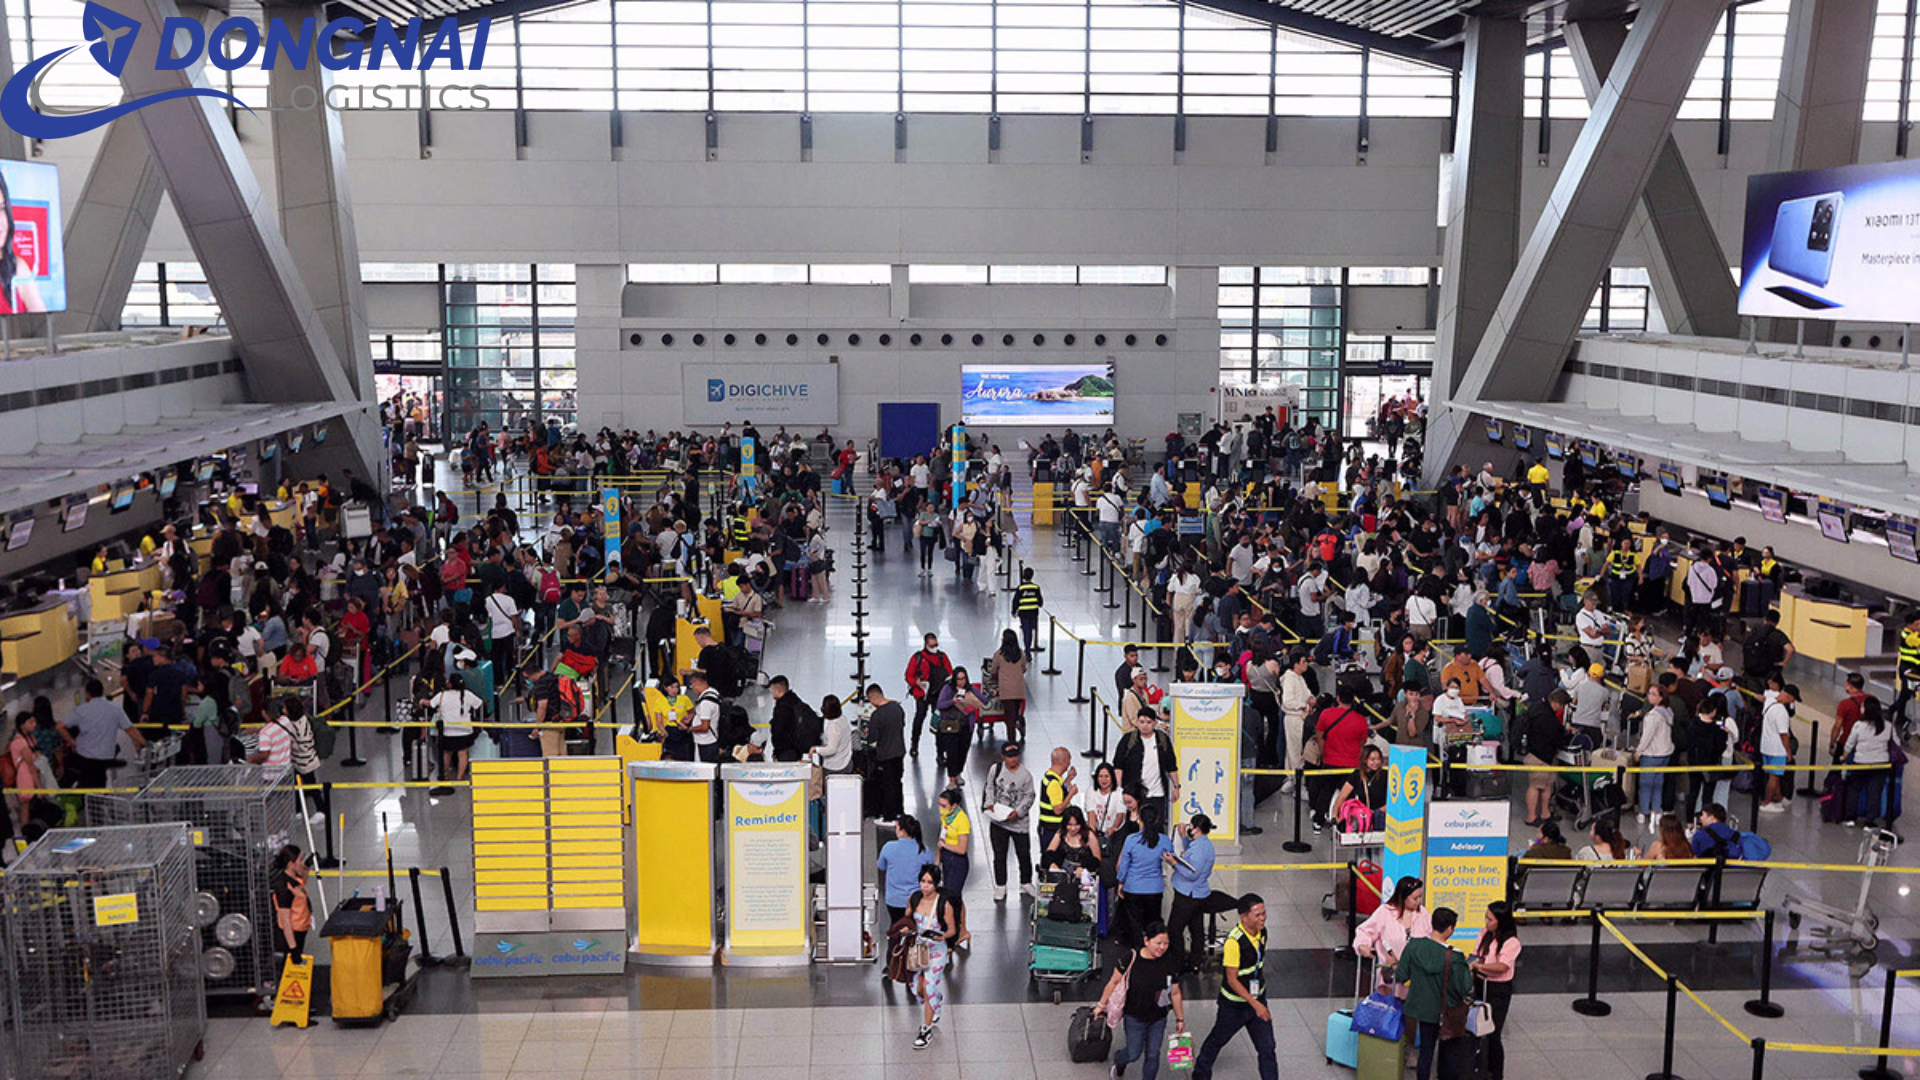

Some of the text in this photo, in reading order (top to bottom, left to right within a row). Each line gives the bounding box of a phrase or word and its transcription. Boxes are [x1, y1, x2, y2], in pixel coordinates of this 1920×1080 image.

[1861, 252, 1910, 267] Masterpiece
[729, 384, 809, 397] DIGICHIVE
[965, 379, 1024, 401] Aurora
[1392, 777, 1398, 798] 3
[1409, 780, 1419, 799] 3
[735, 813, 798, 827] Reminder
[1444, 820, 1493, 829] cebu pacific
[1450, 842, 1485, 852] Advisory
[1433, 865, 1501, 876] Skip the line,
[1432, 877, 1500, 887] GO ONLINE!
[475, 953, 545, 967] cebu pacific
[552, 951, 621, 965] cebu pacific
